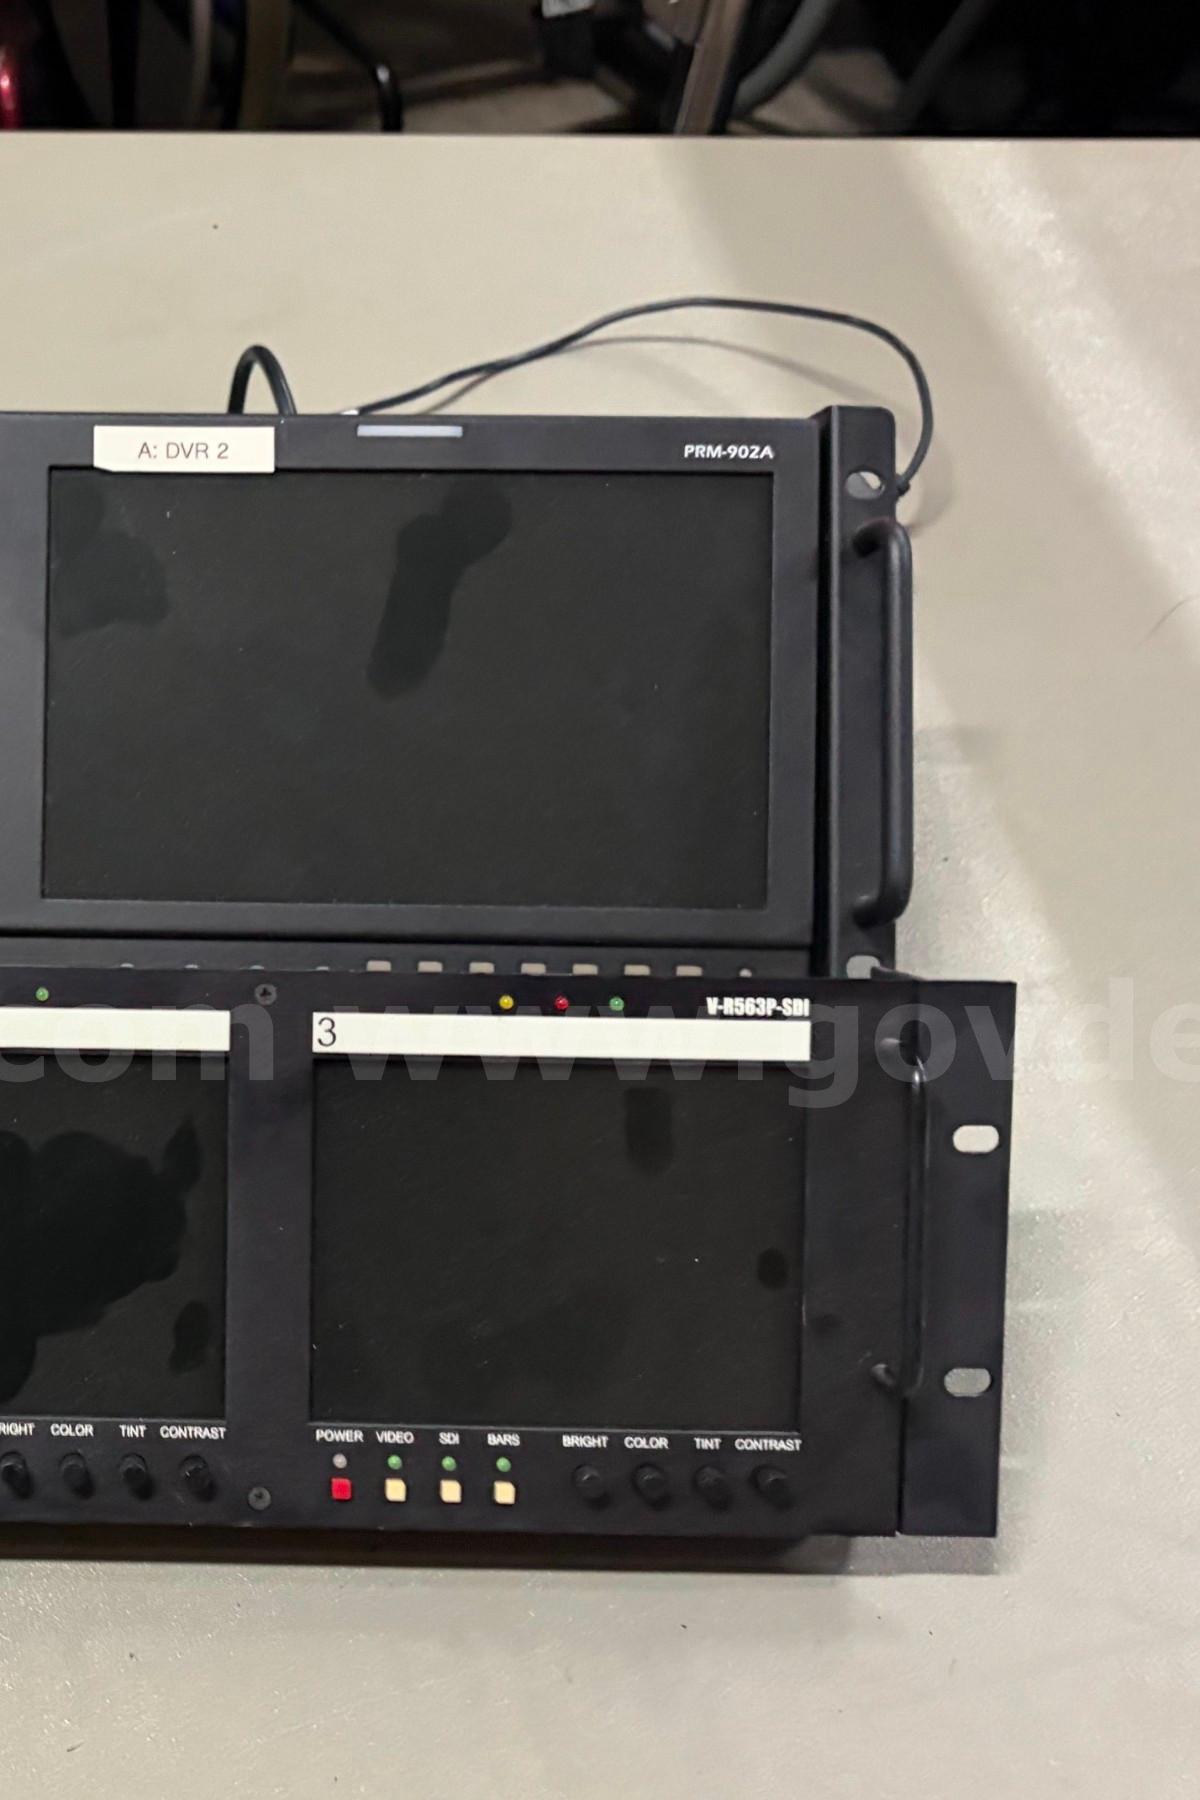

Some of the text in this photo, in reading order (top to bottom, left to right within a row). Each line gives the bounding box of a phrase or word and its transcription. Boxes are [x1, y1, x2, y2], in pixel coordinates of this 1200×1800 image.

[137, 441, 230, 460] A: DVR 2
[683, 444, 775, 460] PRM-902A
[705, 996, 811, 1017] V-R563P-SDI
[317, 1016, 337, 1047] 3
[49, 1422, 94, 1437] COLOR
[118, 1423, 148, 1438] TINT
[159, 1424, 227, 1440] CONTRAST
[315, 1428, 521, 1447] POWER VIDEO SDI BARS
[561, 1434, 803, 1452] BRIGHT COLOR TINT CONTRAST
